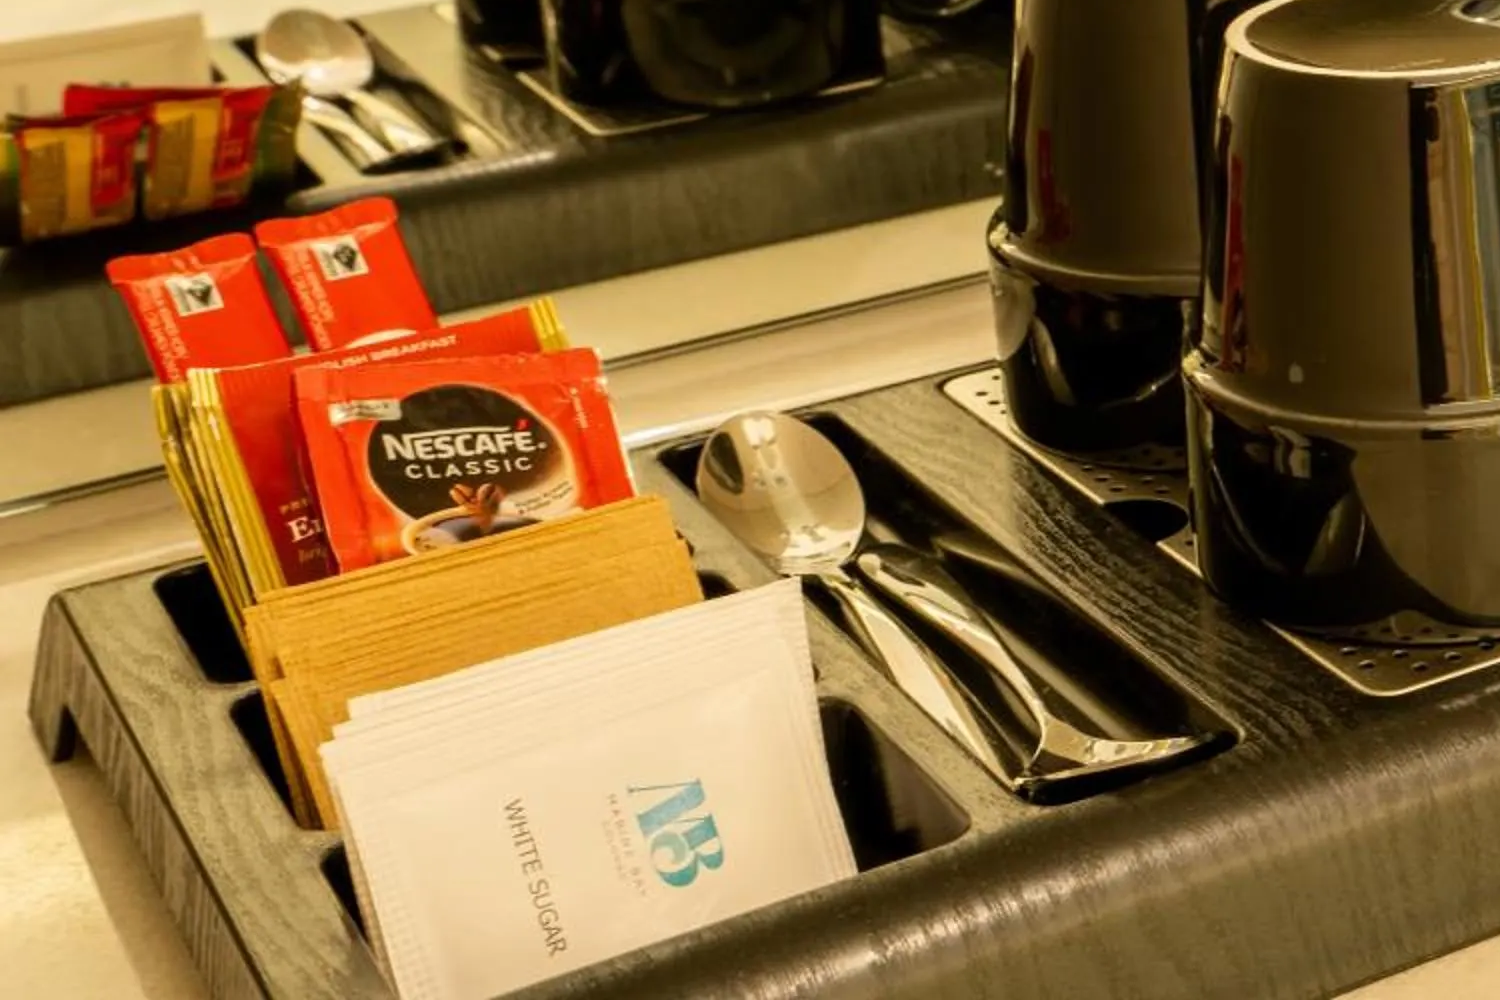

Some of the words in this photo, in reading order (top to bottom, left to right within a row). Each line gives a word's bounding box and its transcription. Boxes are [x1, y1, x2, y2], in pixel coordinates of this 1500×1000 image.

[368, 334, 457, 361] BREAKFAST
[404, 456, 534, 479] CLASSIC
[504, 798, 544, 876] WHITE
[528, 877, 568, 958] SUGAR
